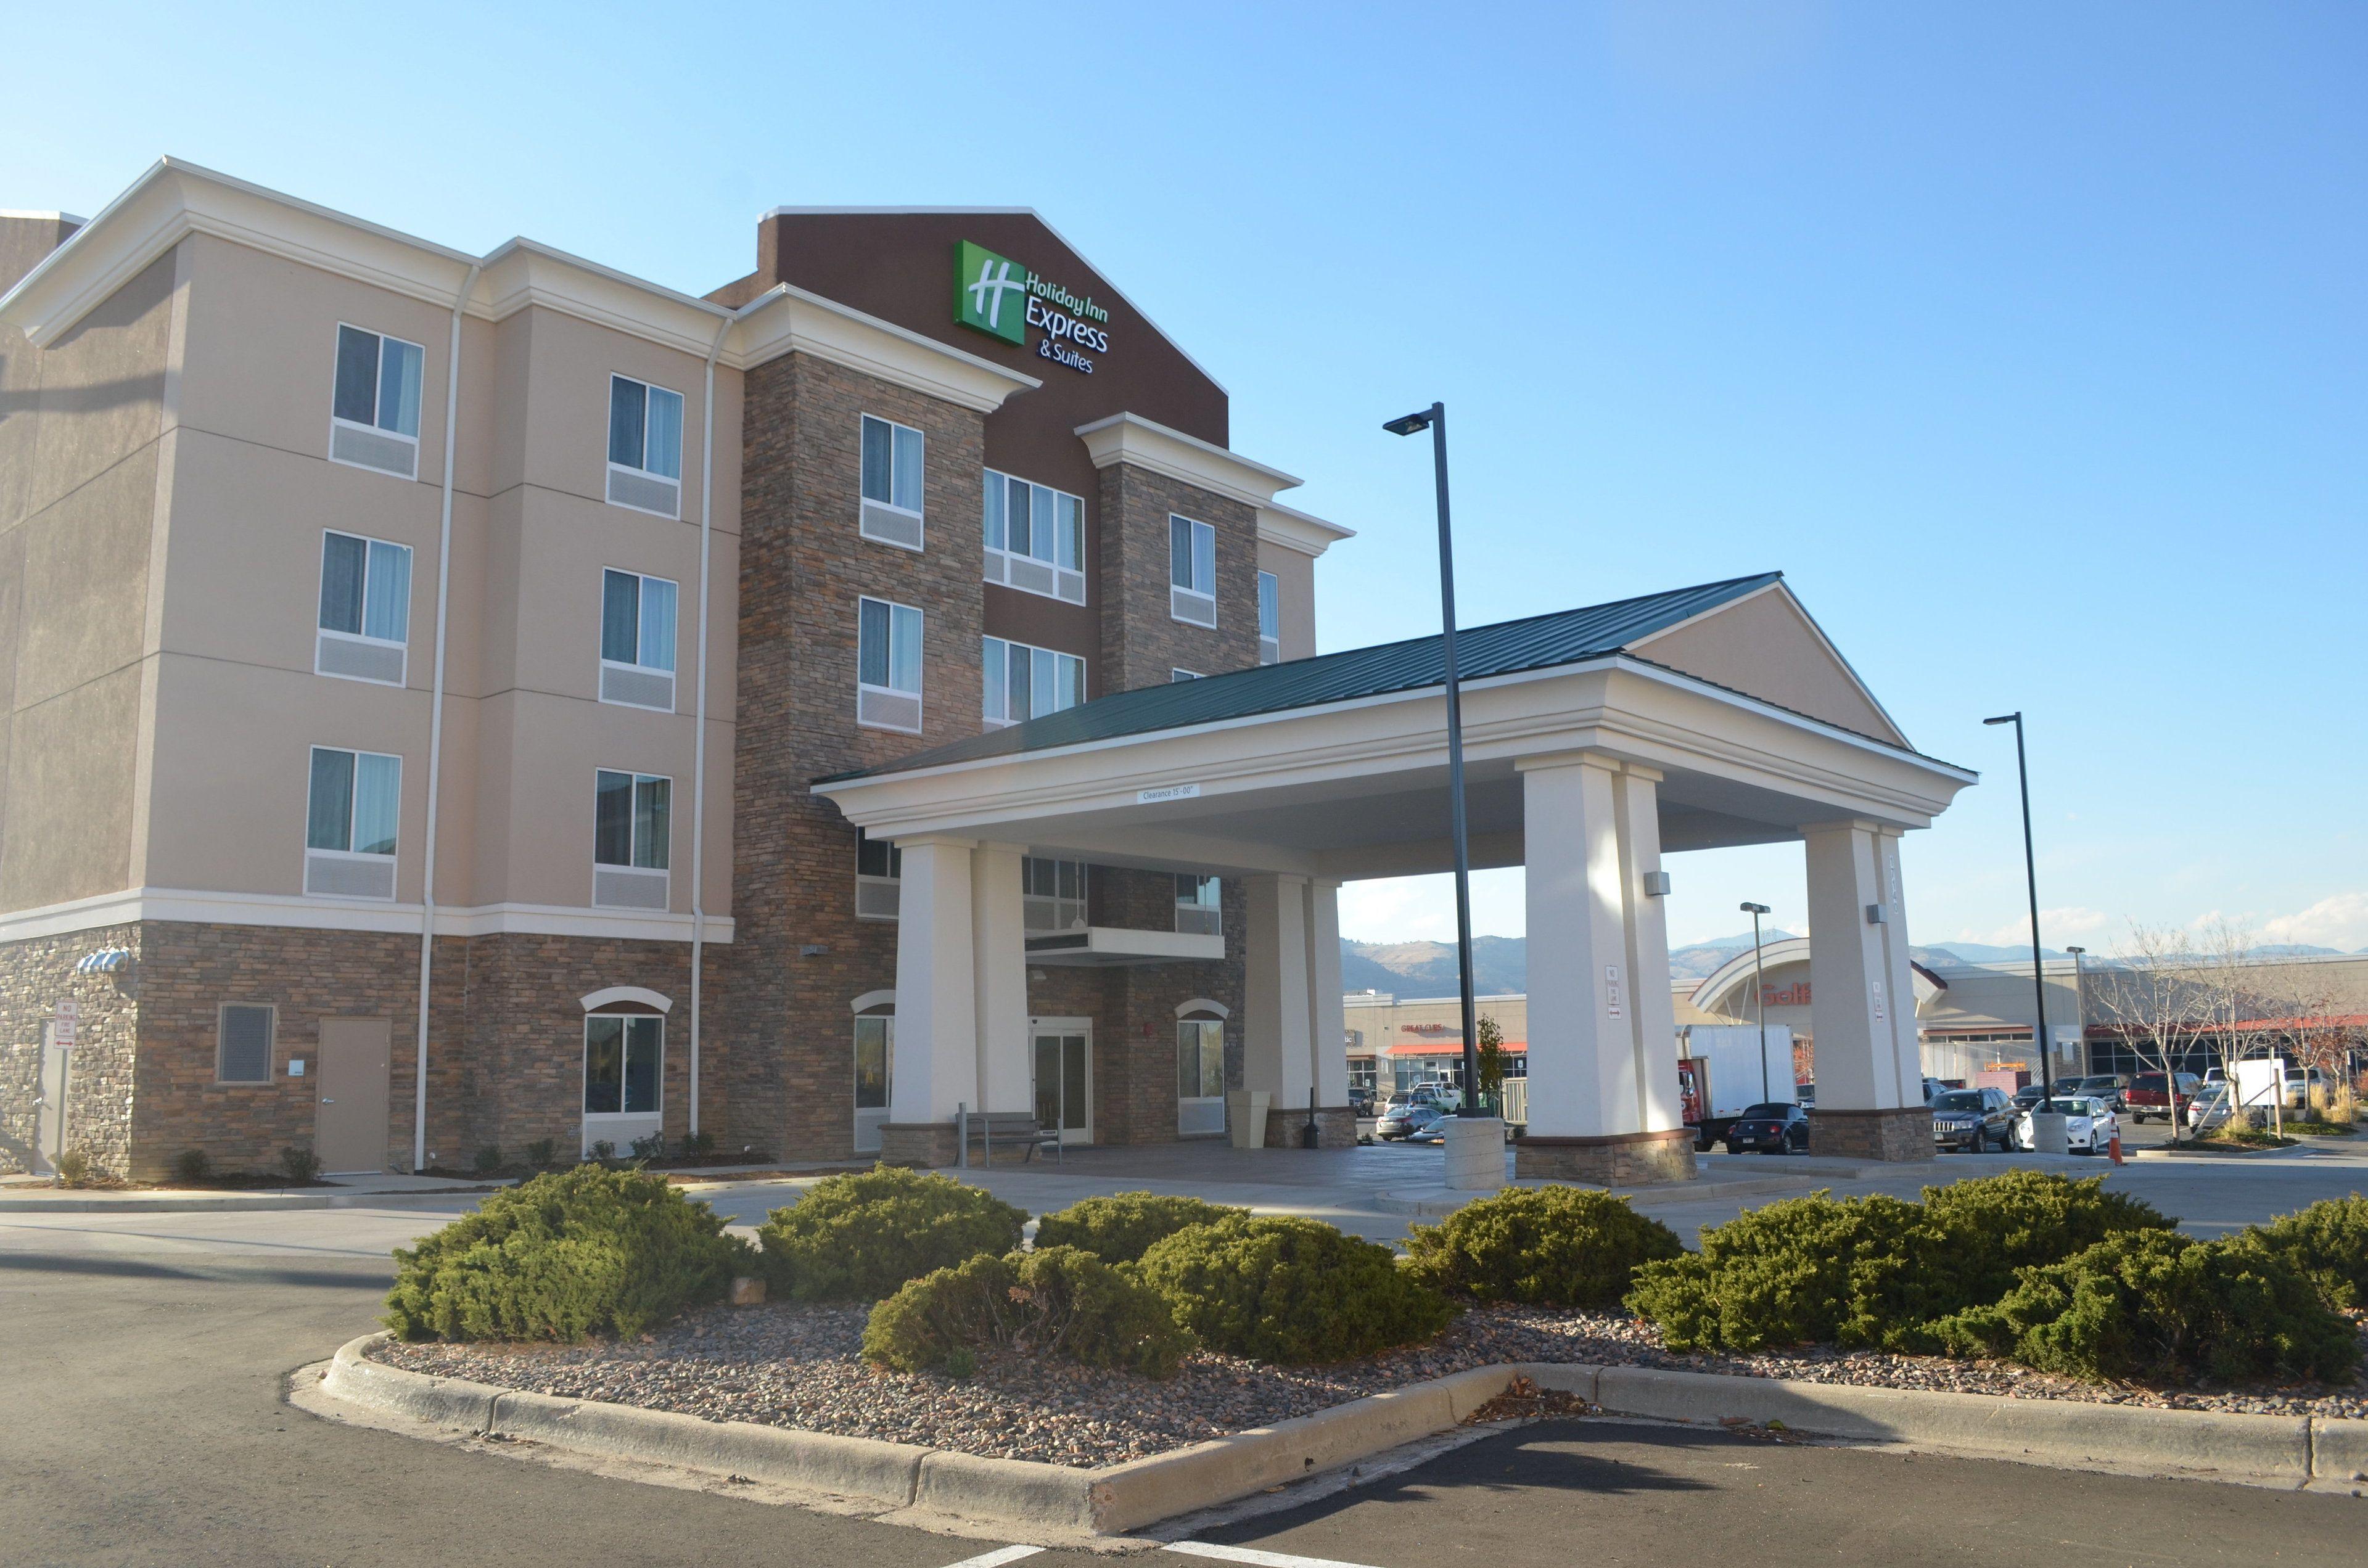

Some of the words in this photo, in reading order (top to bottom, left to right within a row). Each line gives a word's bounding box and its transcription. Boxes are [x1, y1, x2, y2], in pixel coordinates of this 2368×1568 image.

[1025, 271, 1084, 317] Holiday
[1087, 297, 1108, 323] Inn
[1026, 295, 1108, 353] Express
[1040, 339, 1051, 358] &
[1053, 343, 1093, 374] Suites
[1143, 790, 1171, 800] Clearance
[57, 1014, 76, 1022] PARKING
[1401, 1024, 1423, 1032] GREAT
[1424, 1024, 1442, 1032] CLIPS
